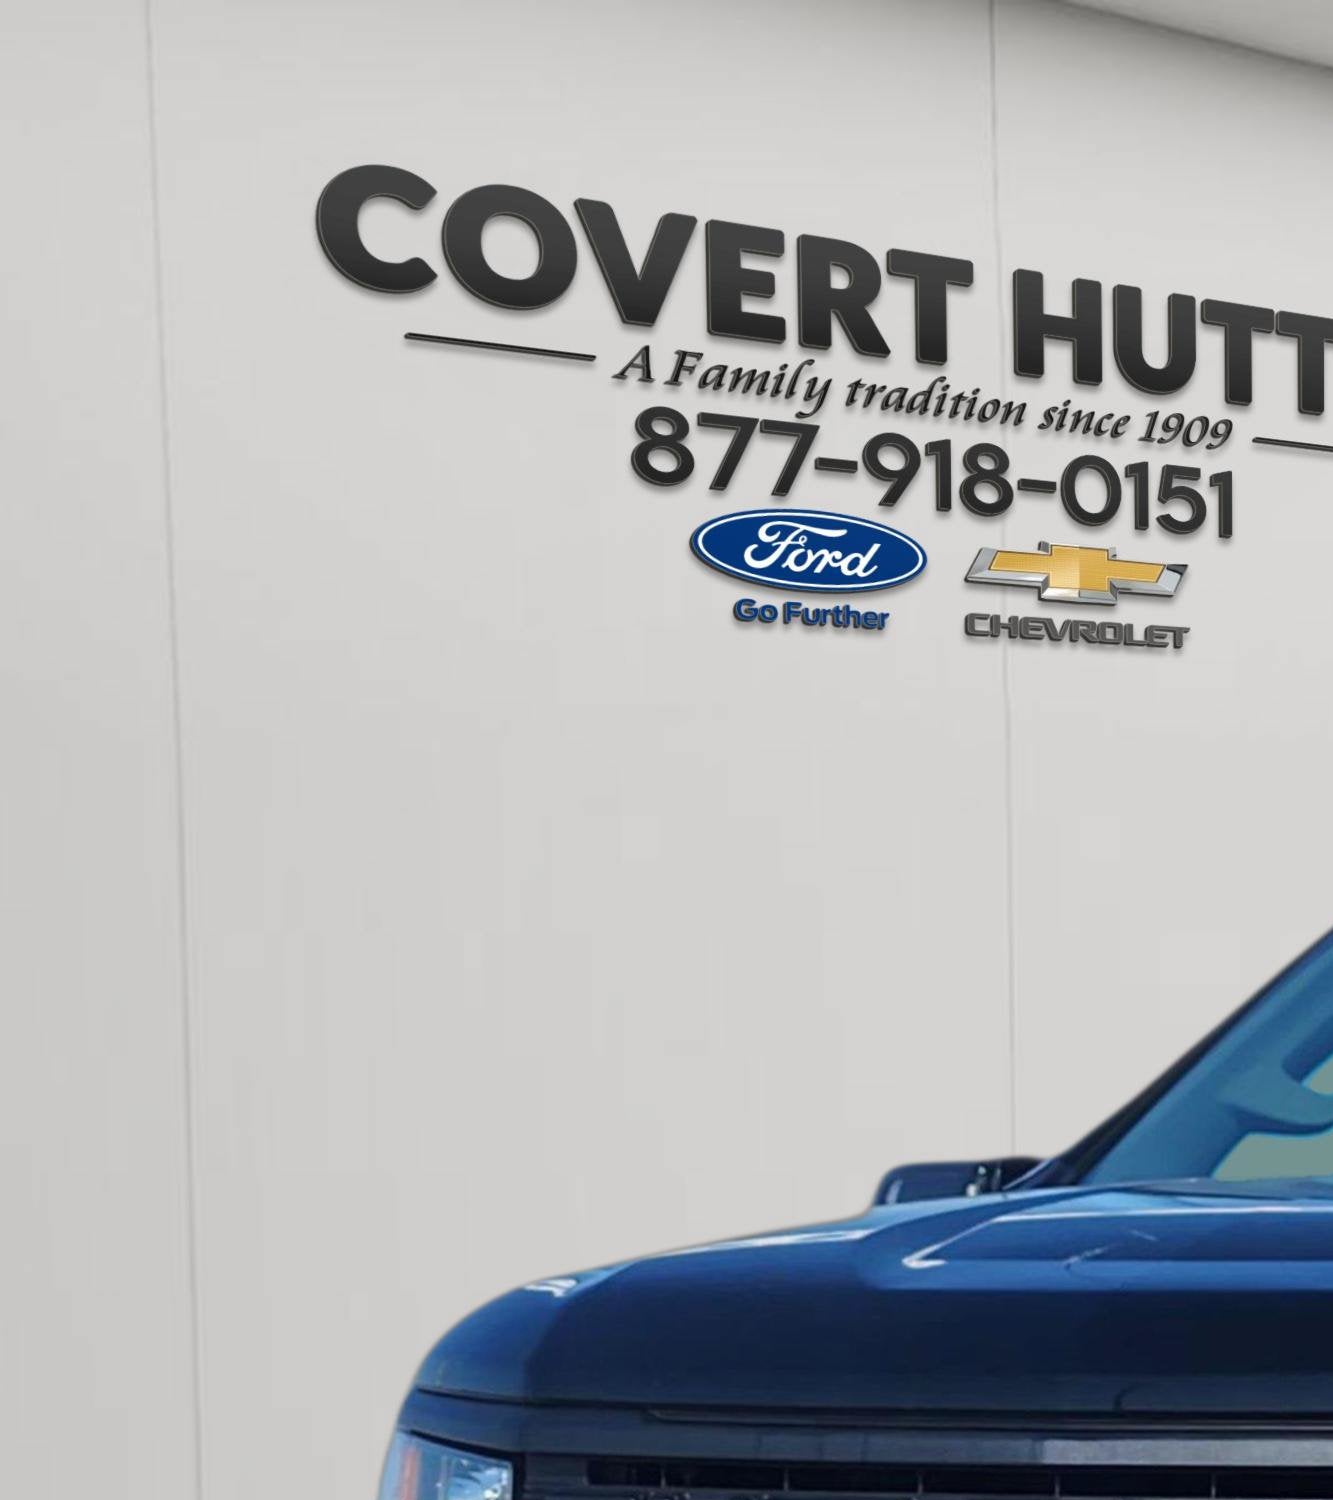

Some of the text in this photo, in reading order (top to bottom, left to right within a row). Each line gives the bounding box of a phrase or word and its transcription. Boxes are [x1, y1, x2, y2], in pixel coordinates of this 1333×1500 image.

[315, 164, 974, 365] COVERT
[611, 345, 1233, 451] A Family tradition since 1909
[630, 406, 1233, 539] 877-918-0151
[743, 520, 881, 578] Ford
[732, 597, 890, 631] Go Further
[963, 612, 1191, 649] CHEVROLET
